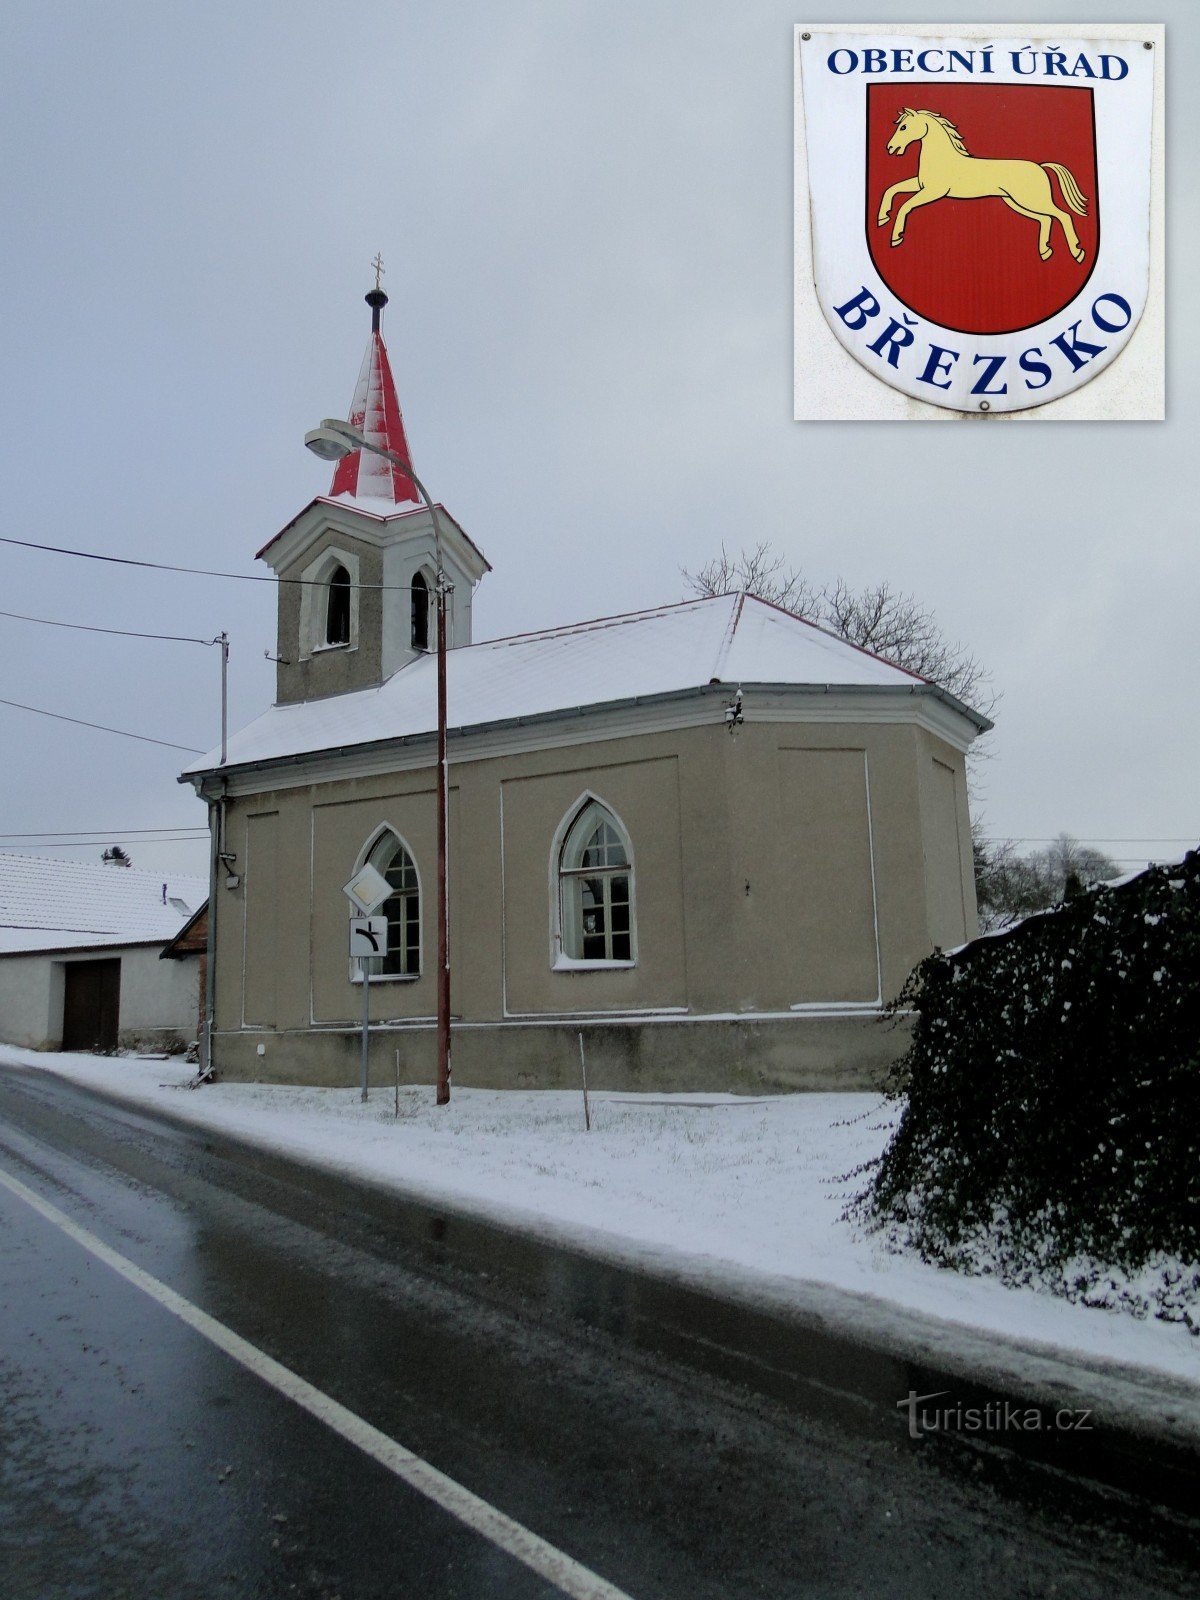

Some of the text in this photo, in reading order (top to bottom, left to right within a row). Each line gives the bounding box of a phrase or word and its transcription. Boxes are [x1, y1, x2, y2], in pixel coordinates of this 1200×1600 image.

[827, 45, 1129, 81] OBECNÍ ÚŘAD
[833, 286, 1132, 395] BŘEZSKO
